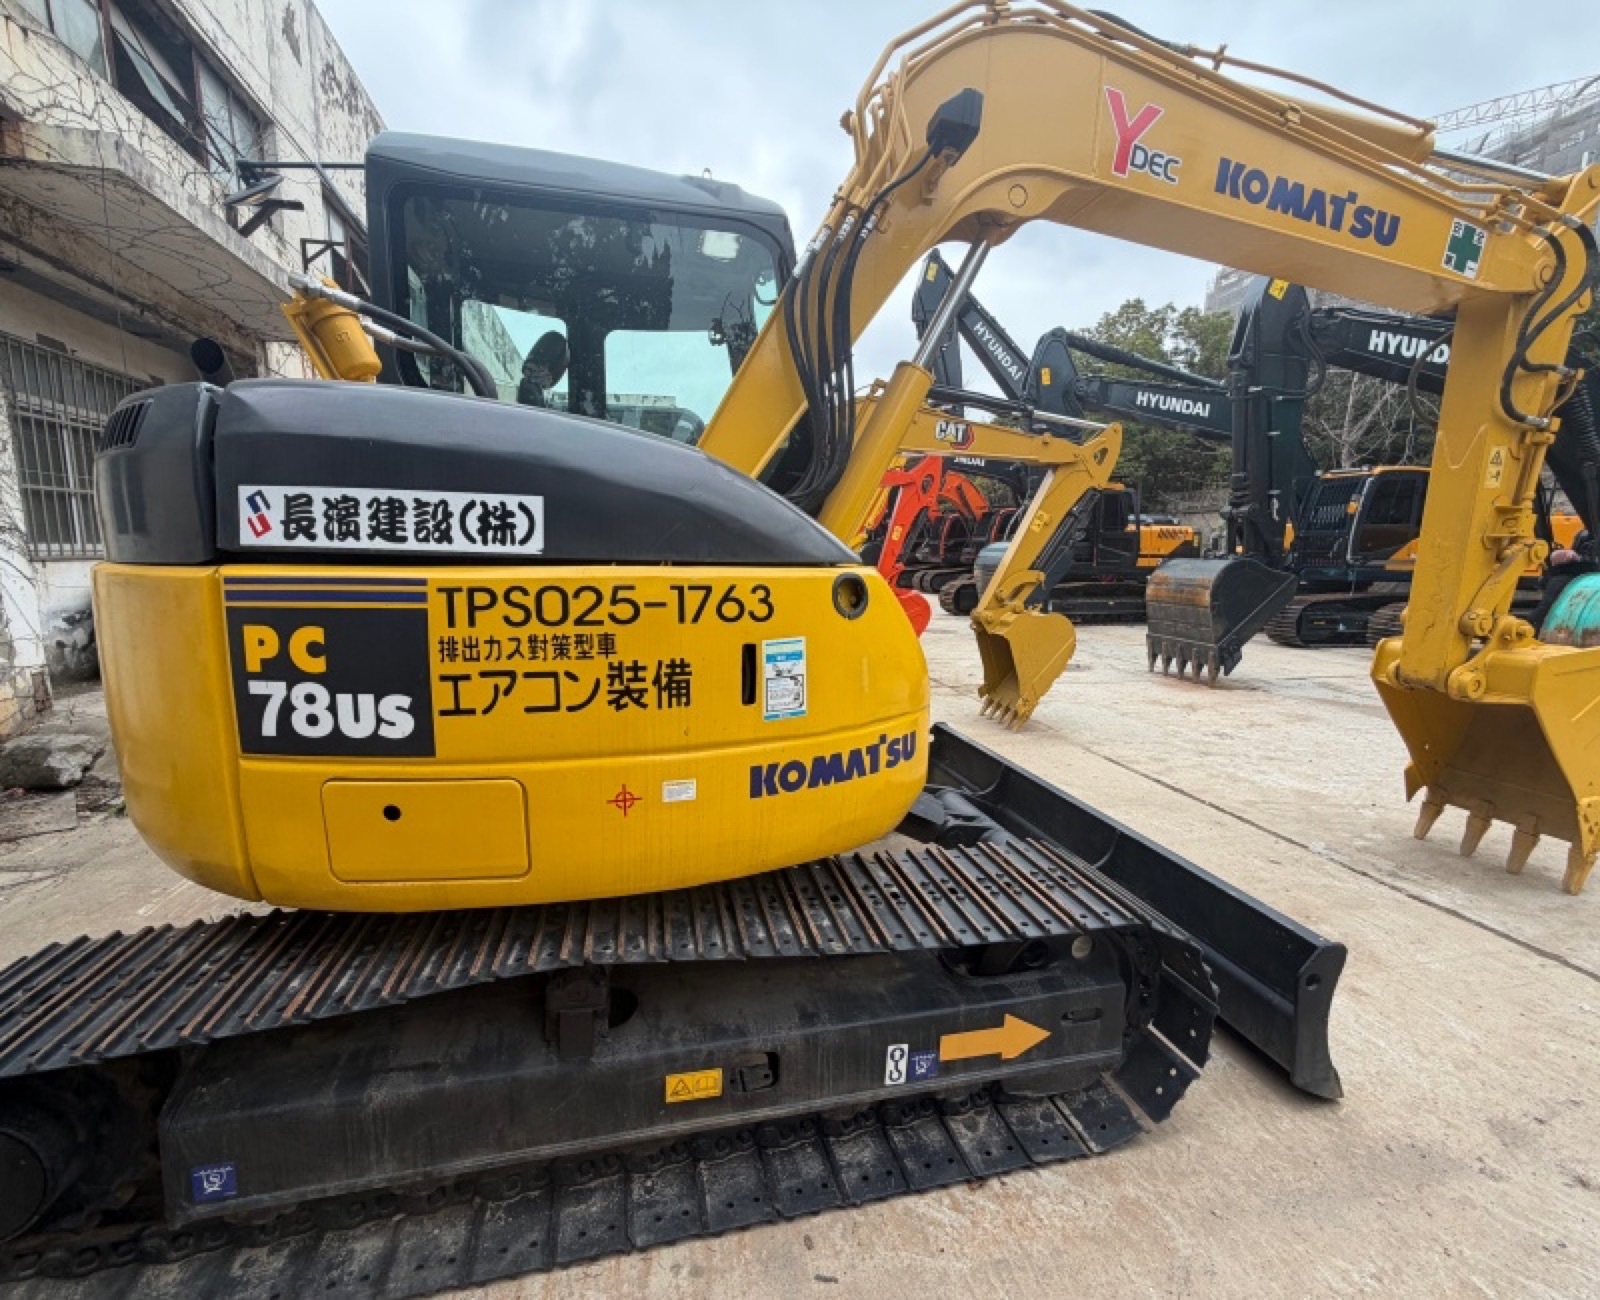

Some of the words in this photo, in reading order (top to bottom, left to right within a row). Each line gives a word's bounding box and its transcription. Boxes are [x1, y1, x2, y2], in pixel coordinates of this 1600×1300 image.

[1214, 156, 1400, 247] KOMATSU
[973, 321, 1023, 381] HYUNDAI
[1368, 329, 1450, 364] HYUND
[1136, 391, 1211, 417] HYUNDAI
[935, 421, 967, 443] CAT
[242, 624, 327, 674] PC
[749, 730, 916, 799] KOMATSU
